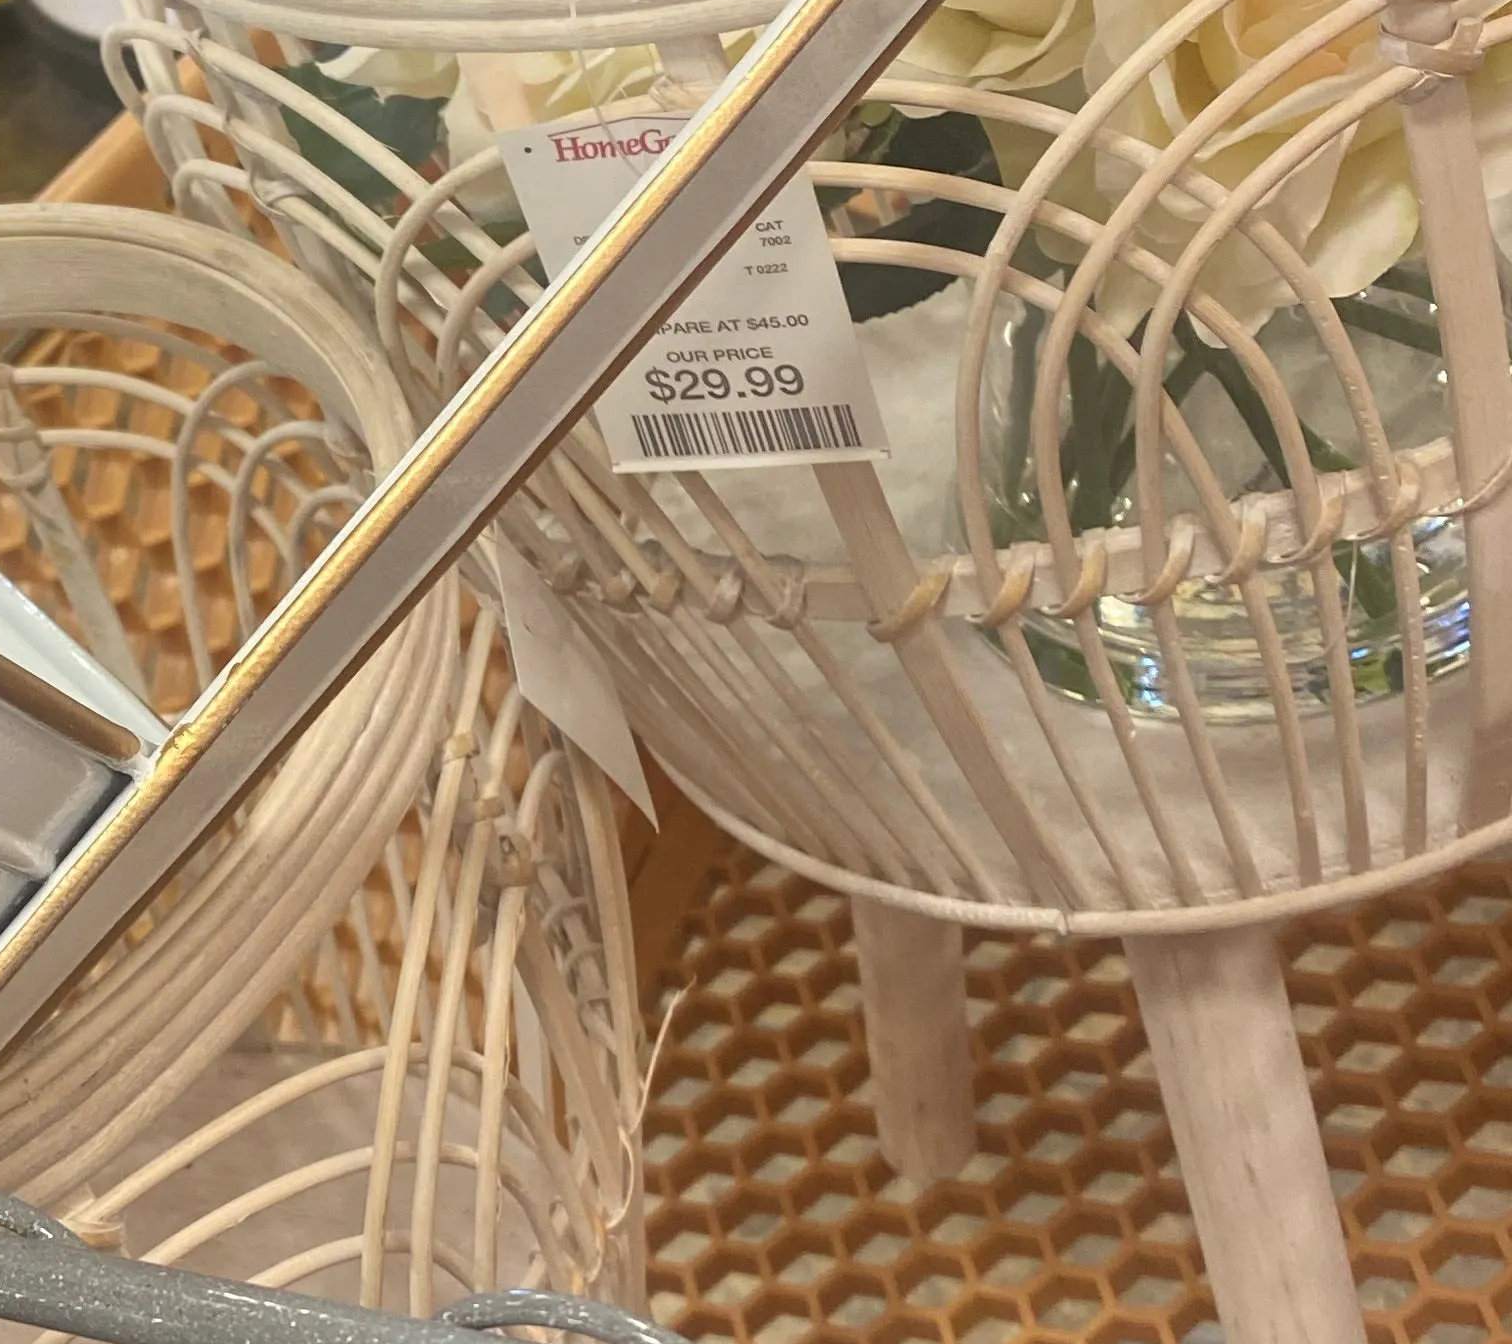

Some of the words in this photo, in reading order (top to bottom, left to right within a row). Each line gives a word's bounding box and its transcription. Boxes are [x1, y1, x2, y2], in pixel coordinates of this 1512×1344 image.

[755, 220, 784, 232] CAT
[756, 262, 789, 274] 0222
[717, 319, 741, 333] AT
[746, 313, 809, 331] $45.00
[666, 349, 709, 364] OUR
[713, 346, 774, 362] PRICE
[644, 365, 805, 406] $29.99
